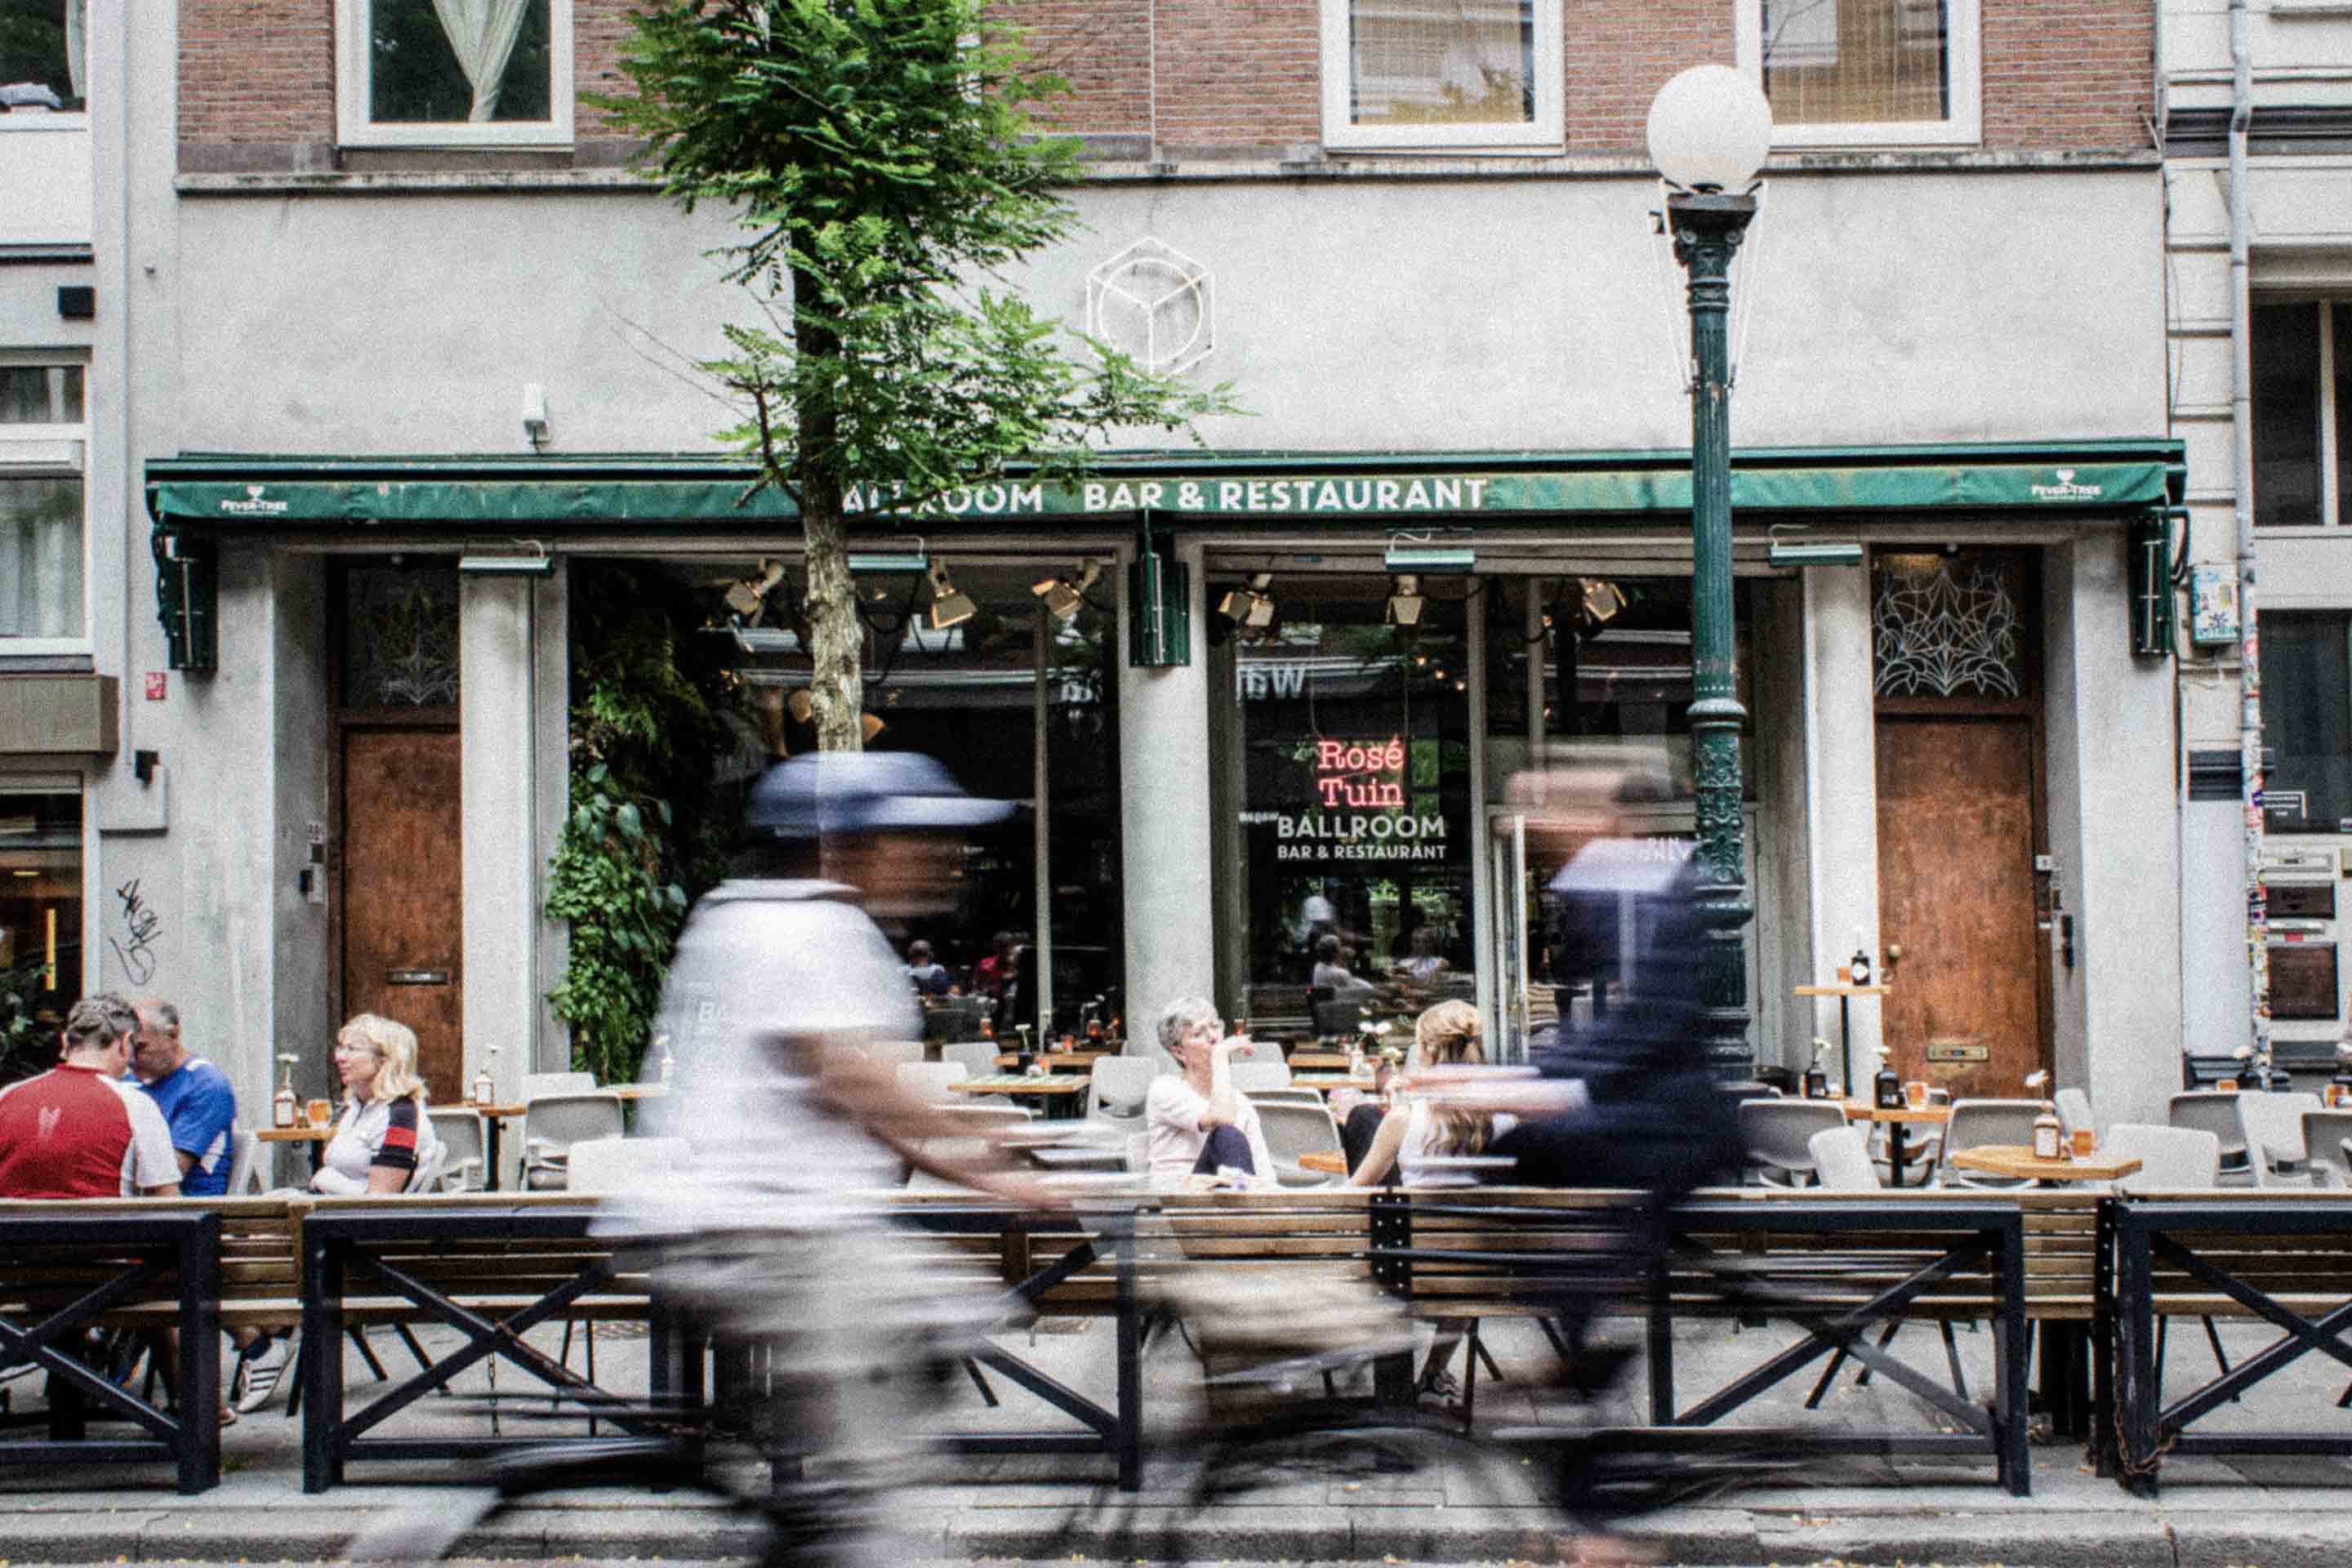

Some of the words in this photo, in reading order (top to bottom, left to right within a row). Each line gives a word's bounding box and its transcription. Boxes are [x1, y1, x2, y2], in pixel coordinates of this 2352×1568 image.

[842, 483, 1042, 513] ALLOOM
[1083, 483, 1163, 510] BAR
[1177, 481, 1205, 510] &
[1219, 479, 1486, 510] RESTAURANT
[1316, 733, 1405, 770] Rosé
[1318, 777, 1405, 807] Tuin
[1277, 815, 1446, 839] BALLROOM
[1277, 844, 1312, 860] BAR
[1317, 844, 1330, 860] &
[1334, 844, 1447, 860] RESTAURANT
